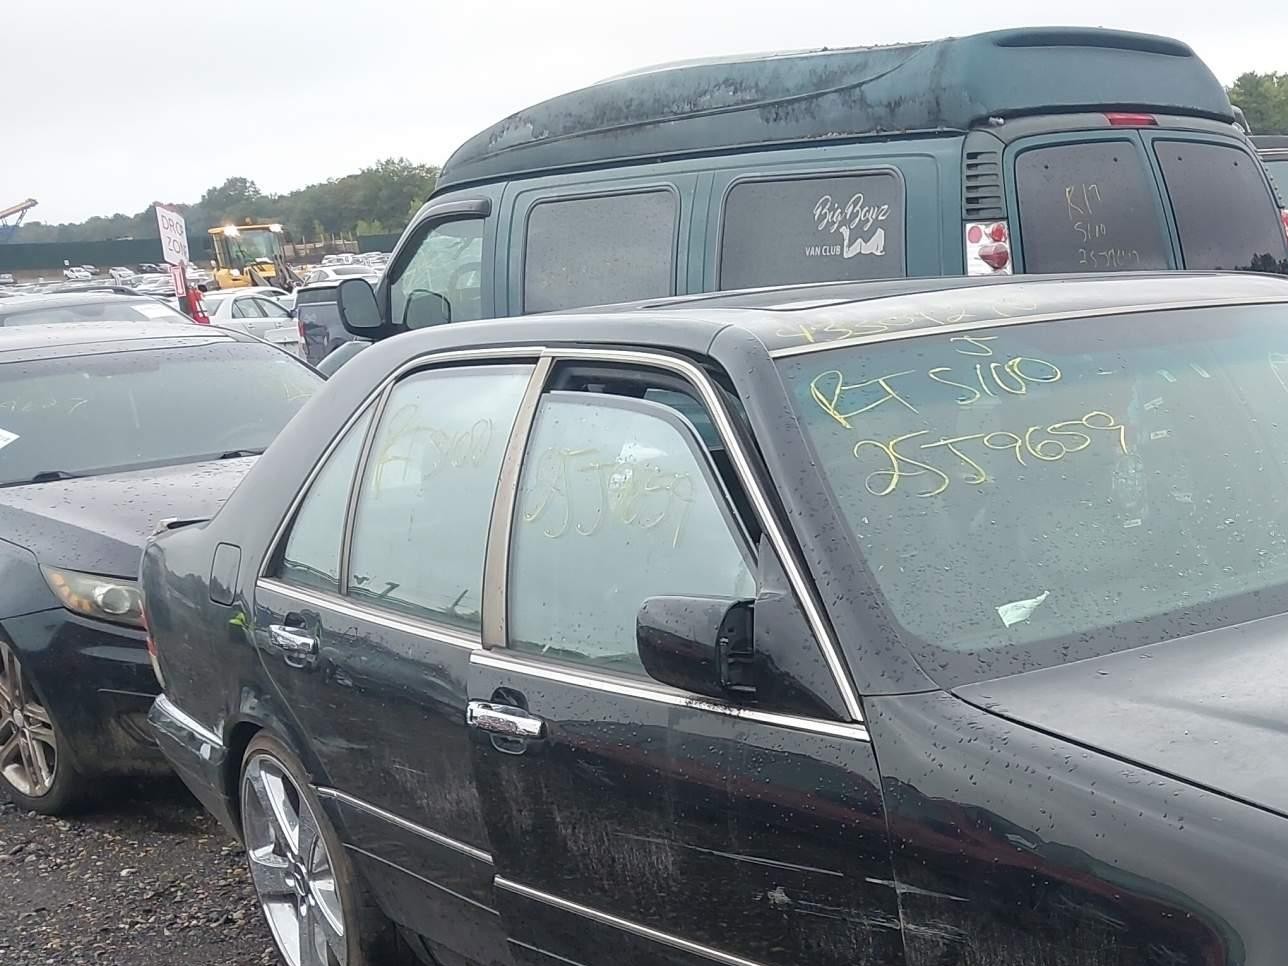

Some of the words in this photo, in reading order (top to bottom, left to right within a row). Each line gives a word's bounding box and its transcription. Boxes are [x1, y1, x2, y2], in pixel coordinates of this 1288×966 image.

[813, 195, 846, 233] Big
[805, 246, 821, 256] VAN
[822, 245, 841, 256] CLUB
